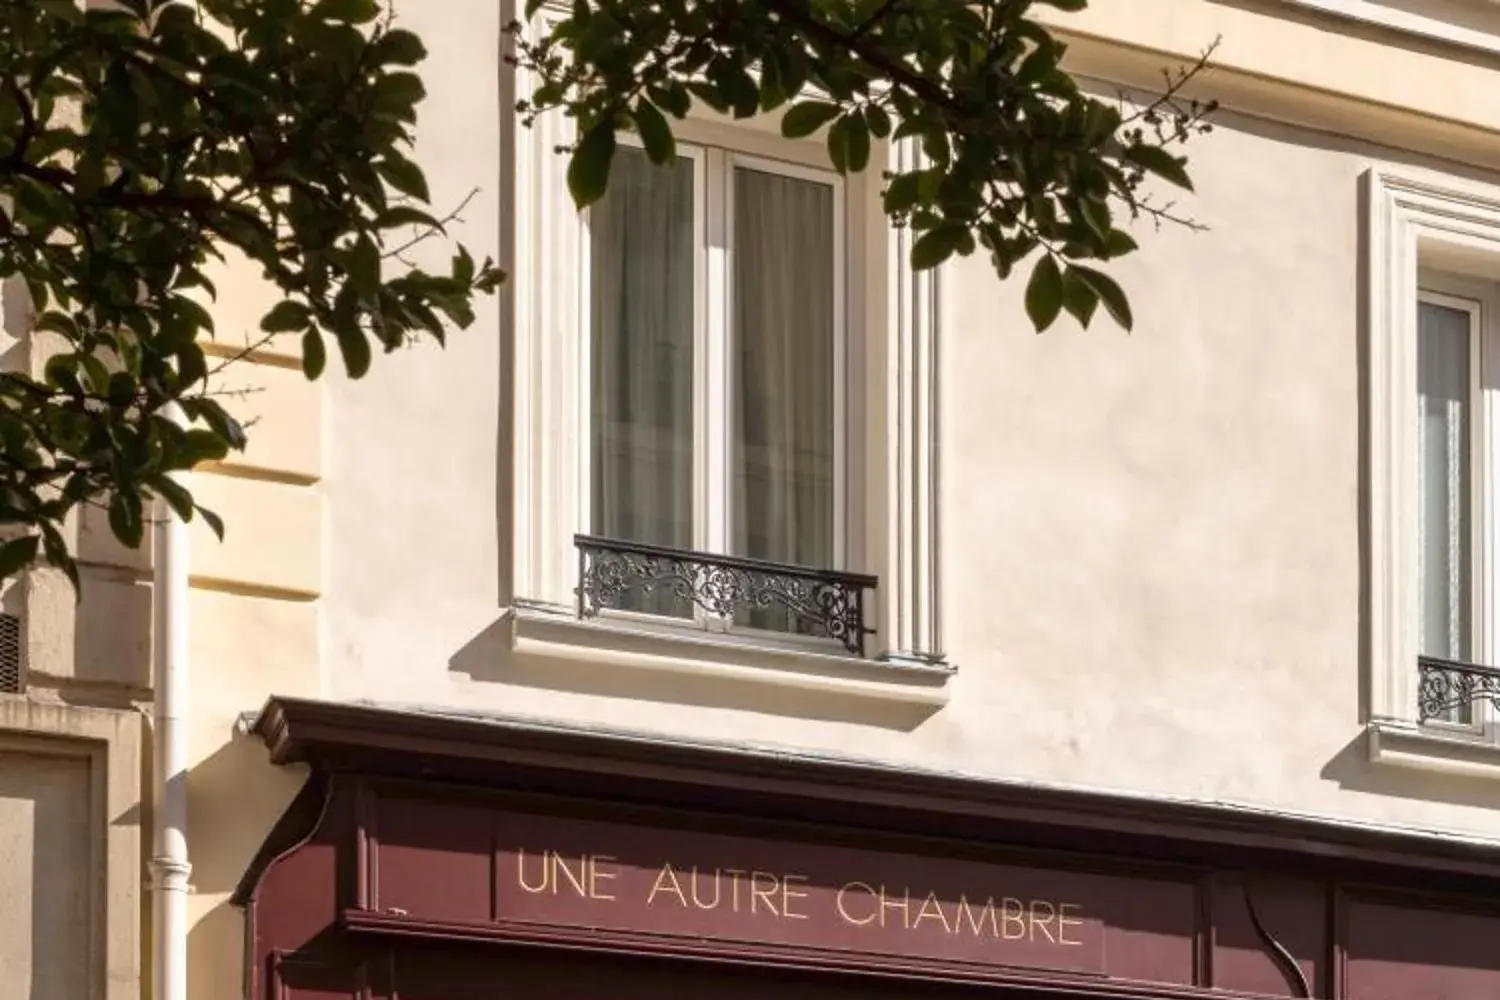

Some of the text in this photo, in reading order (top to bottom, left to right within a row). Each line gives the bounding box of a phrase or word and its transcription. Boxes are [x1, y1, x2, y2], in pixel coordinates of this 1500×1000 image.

[517, 848, 1083, 946] UNE AUTRE CHAMBRE
